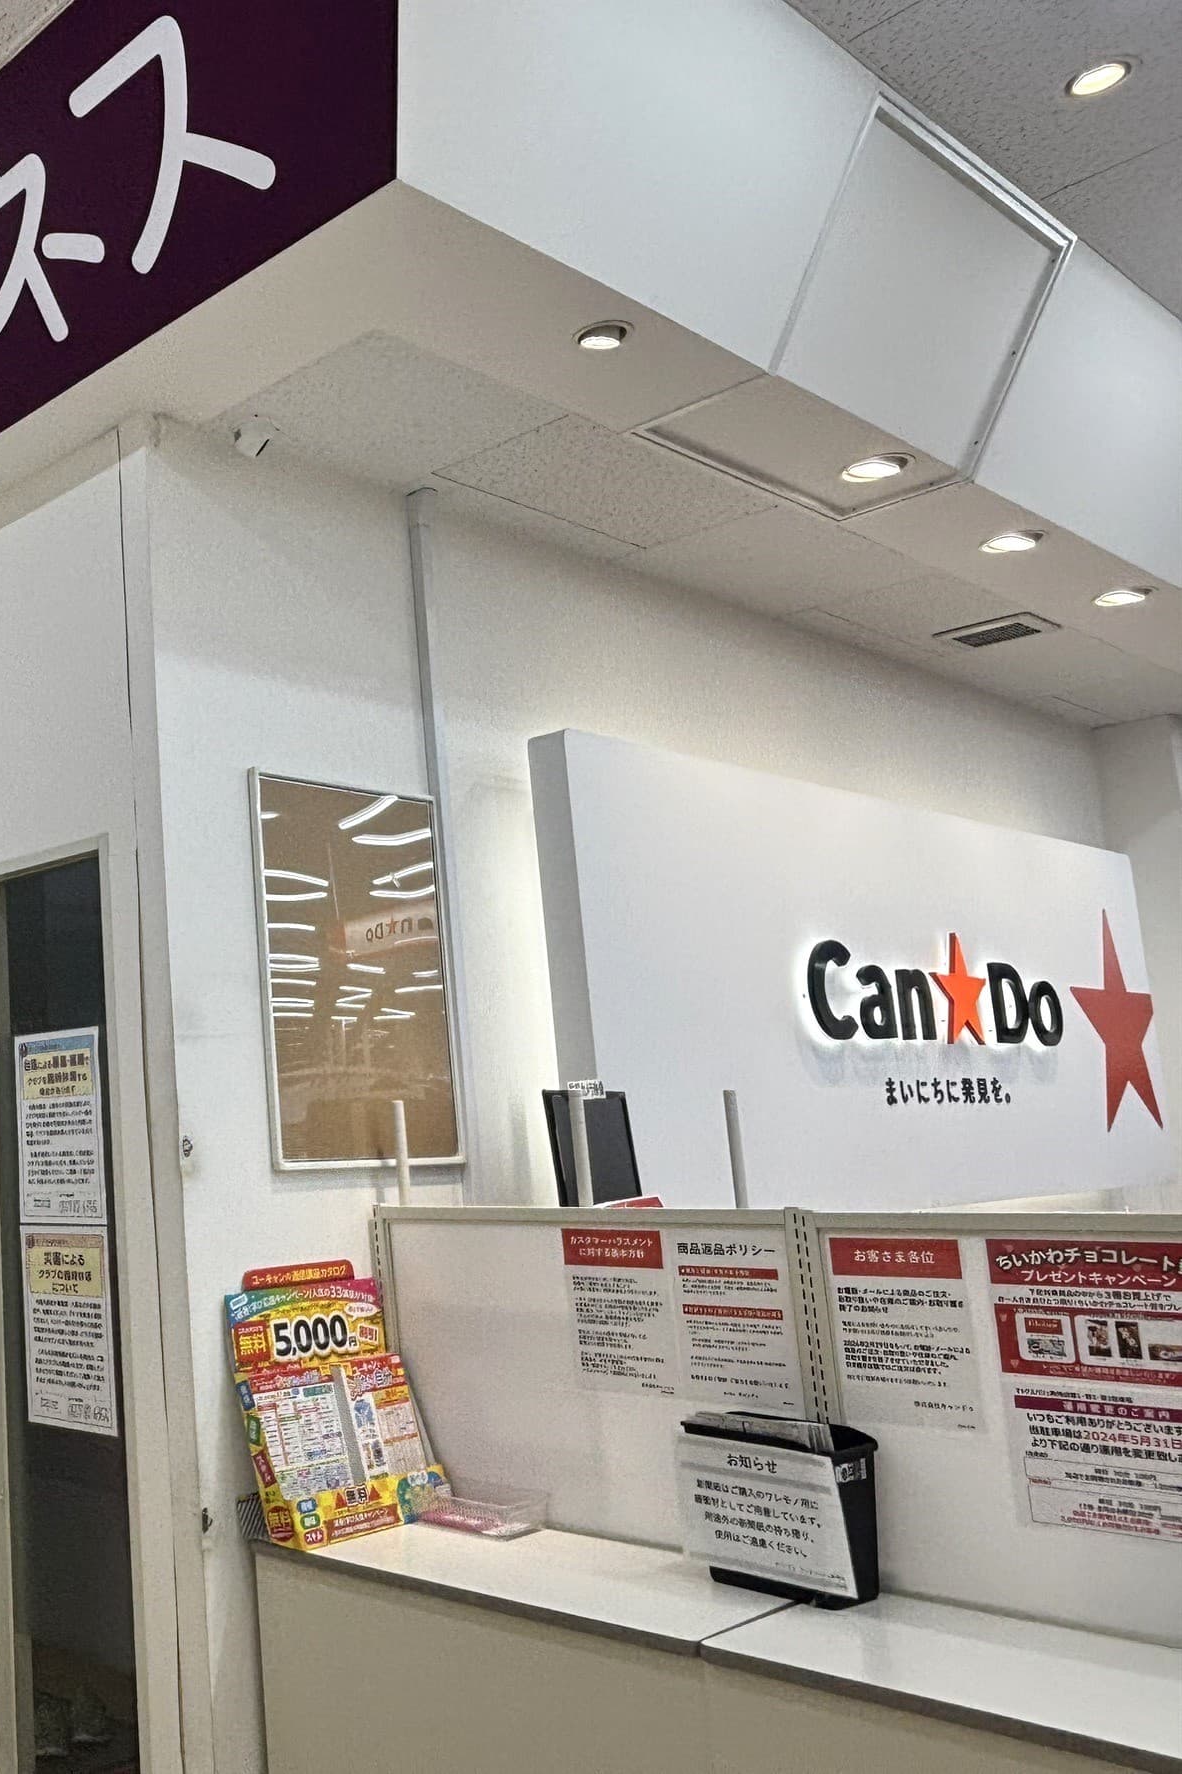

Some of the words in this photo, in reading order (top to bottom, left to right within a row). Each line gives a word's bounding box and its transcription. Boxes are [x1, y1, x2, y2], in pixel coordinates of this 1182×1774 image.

[885, 1077, 1012, 1106] まいにちに発見を。
[676, 1242, 776, 1257] 商品返品ポリシー
[995, 1247, 1182, 1274] ちいかわチョコレート
[1020, 1270, 1177, 1288] プレゼントキャンペーン
[726, 1453, 778, 1474] お知らせ
